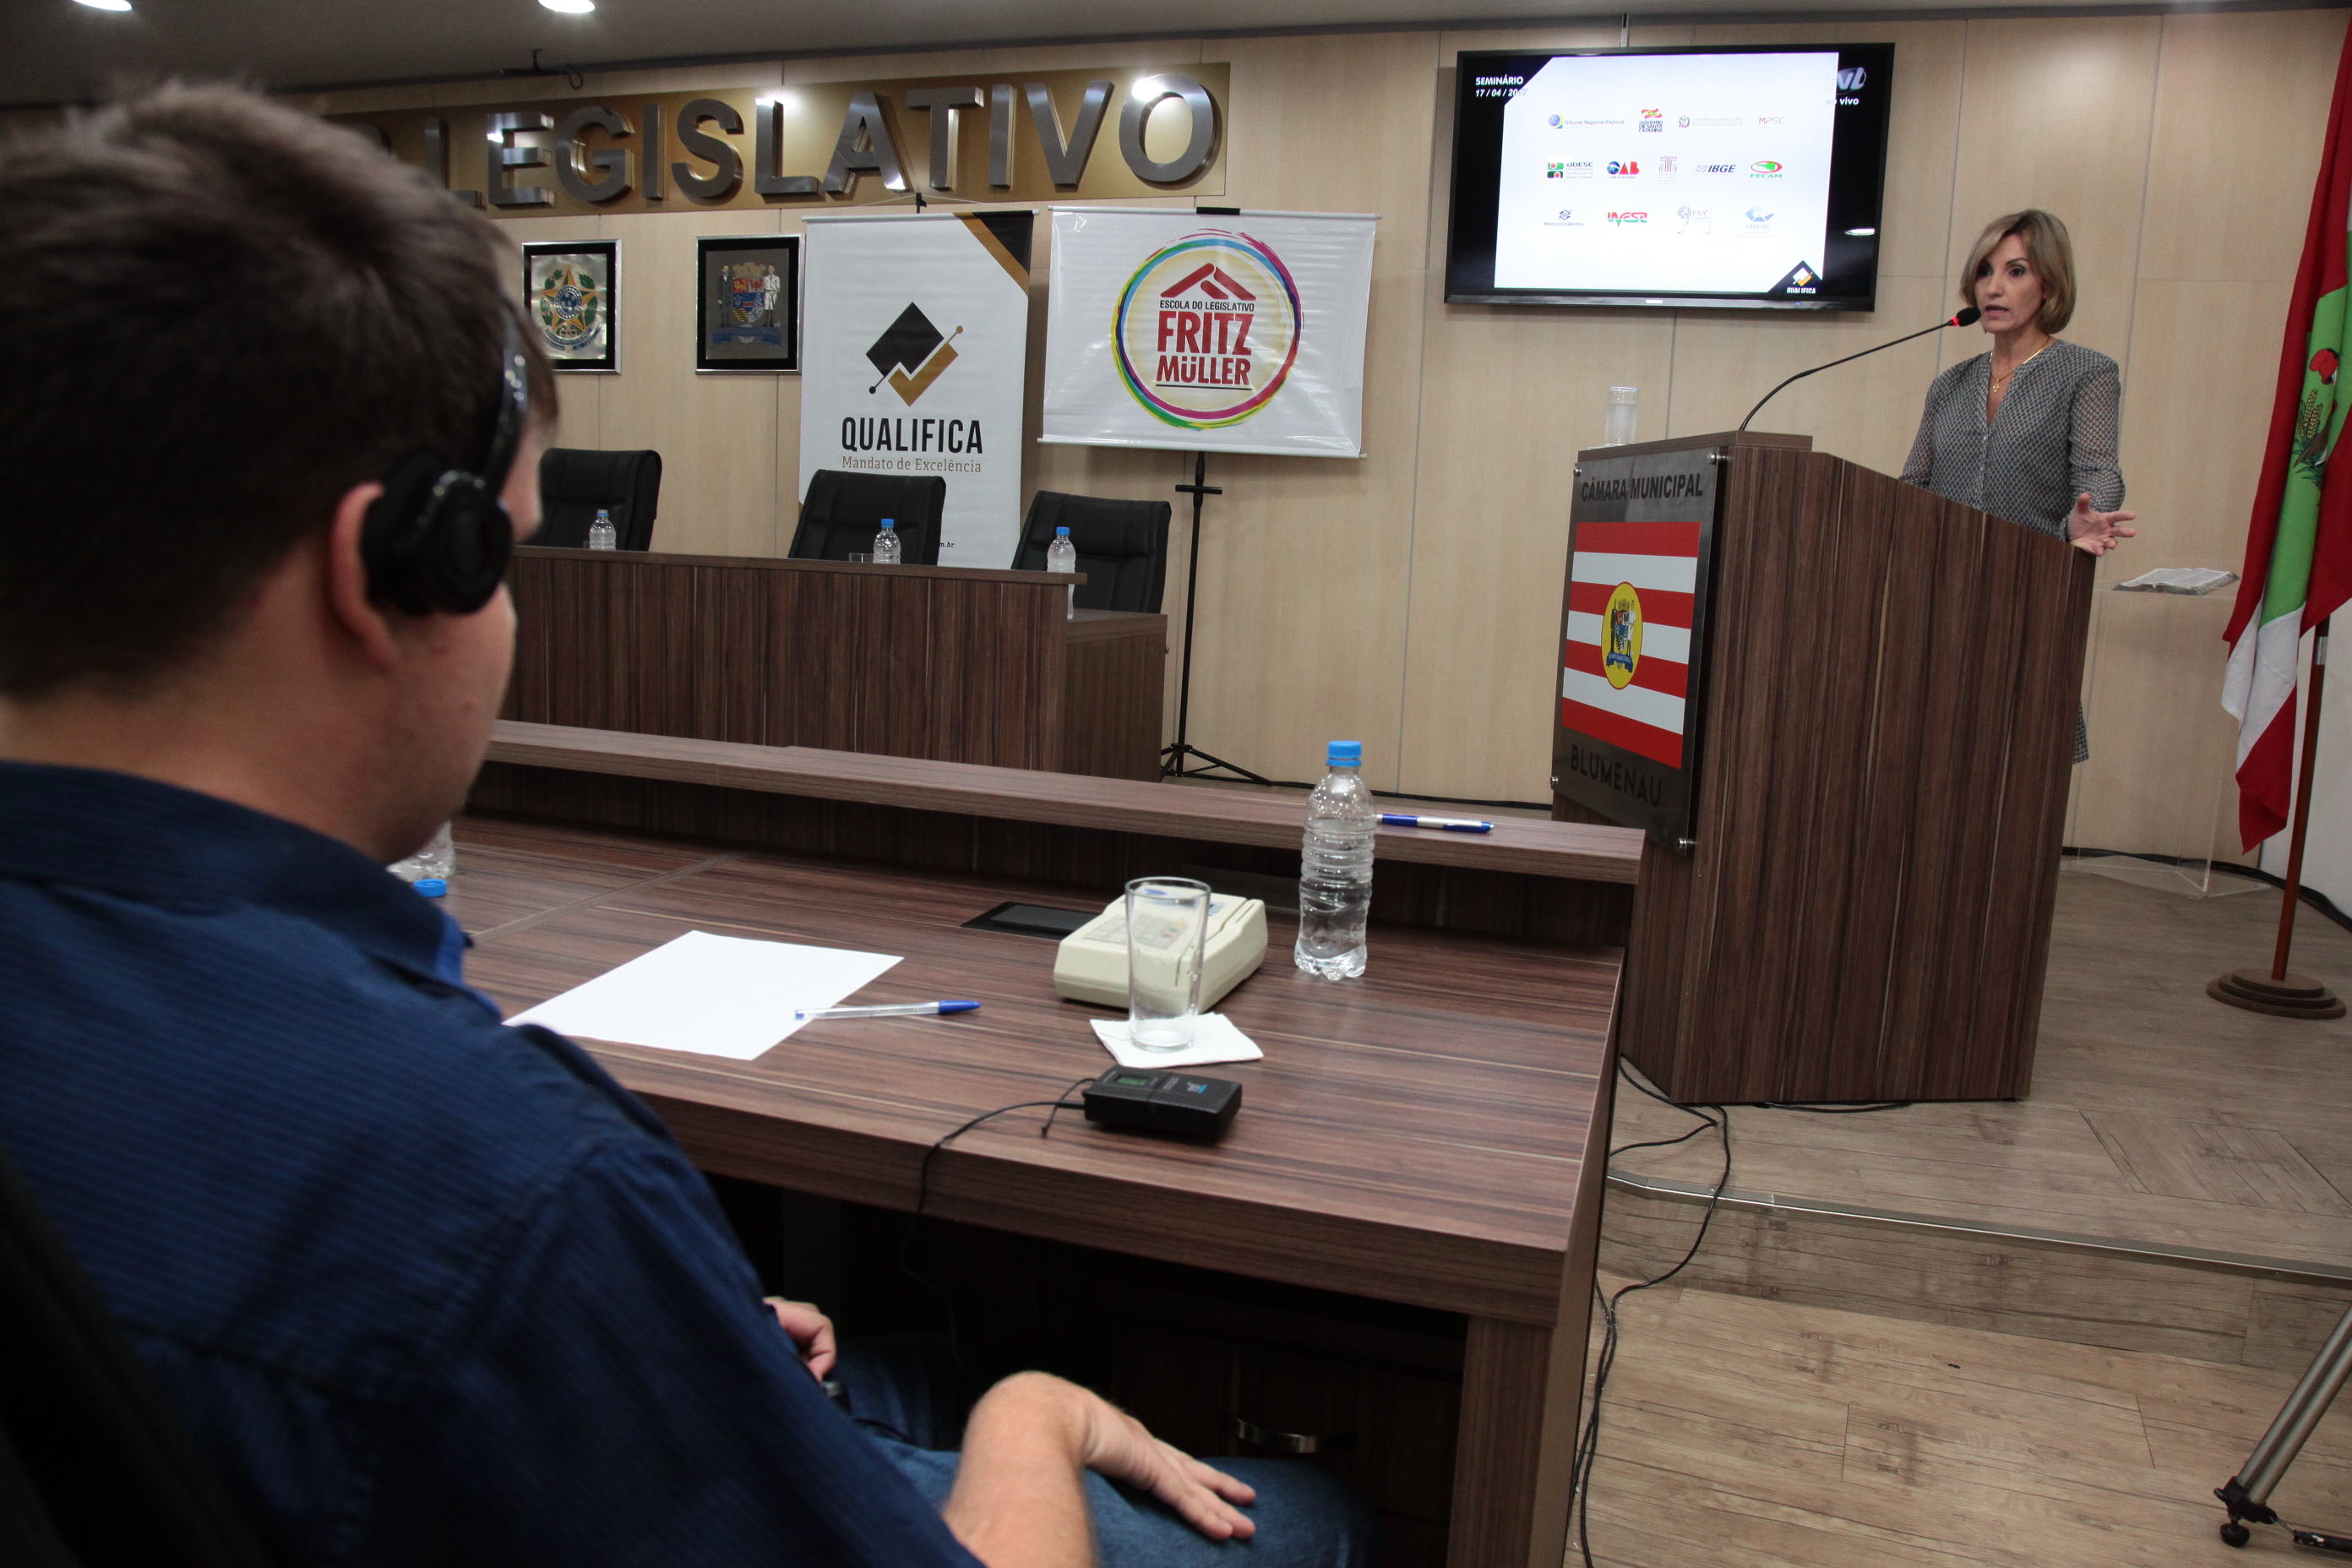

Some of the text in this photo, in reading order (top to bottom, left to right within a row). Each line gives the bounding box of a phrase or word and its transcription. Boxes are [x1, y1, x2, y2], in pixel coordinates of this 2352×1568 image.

[1475, 74, 1524, 85] SEMINÁRIO
[1475, 89, 1484, 97] 17
[1491, 89, 1501, 97] 04
[1839, 96, 1859, 105] vivo
[424, 74, 1216, 209] LEGISLATIVO
[1607, 161, 1640, 175] OAB
[1708, 165, 1736, 173] IBGE
[1160, 300, 1255, 312] ESCOLA DO LEGISLATIVO
[1157, 310, 1254, 356] FRITZ
[841, 416, 983, 454] QUALIFICA
[841, 455, 982, 473] Mandato de Excelência
[1582, 472, 1703, 502] CÂMARA MUNICIPAL
[1571, 743, 1662, 808] BLUMENAU
